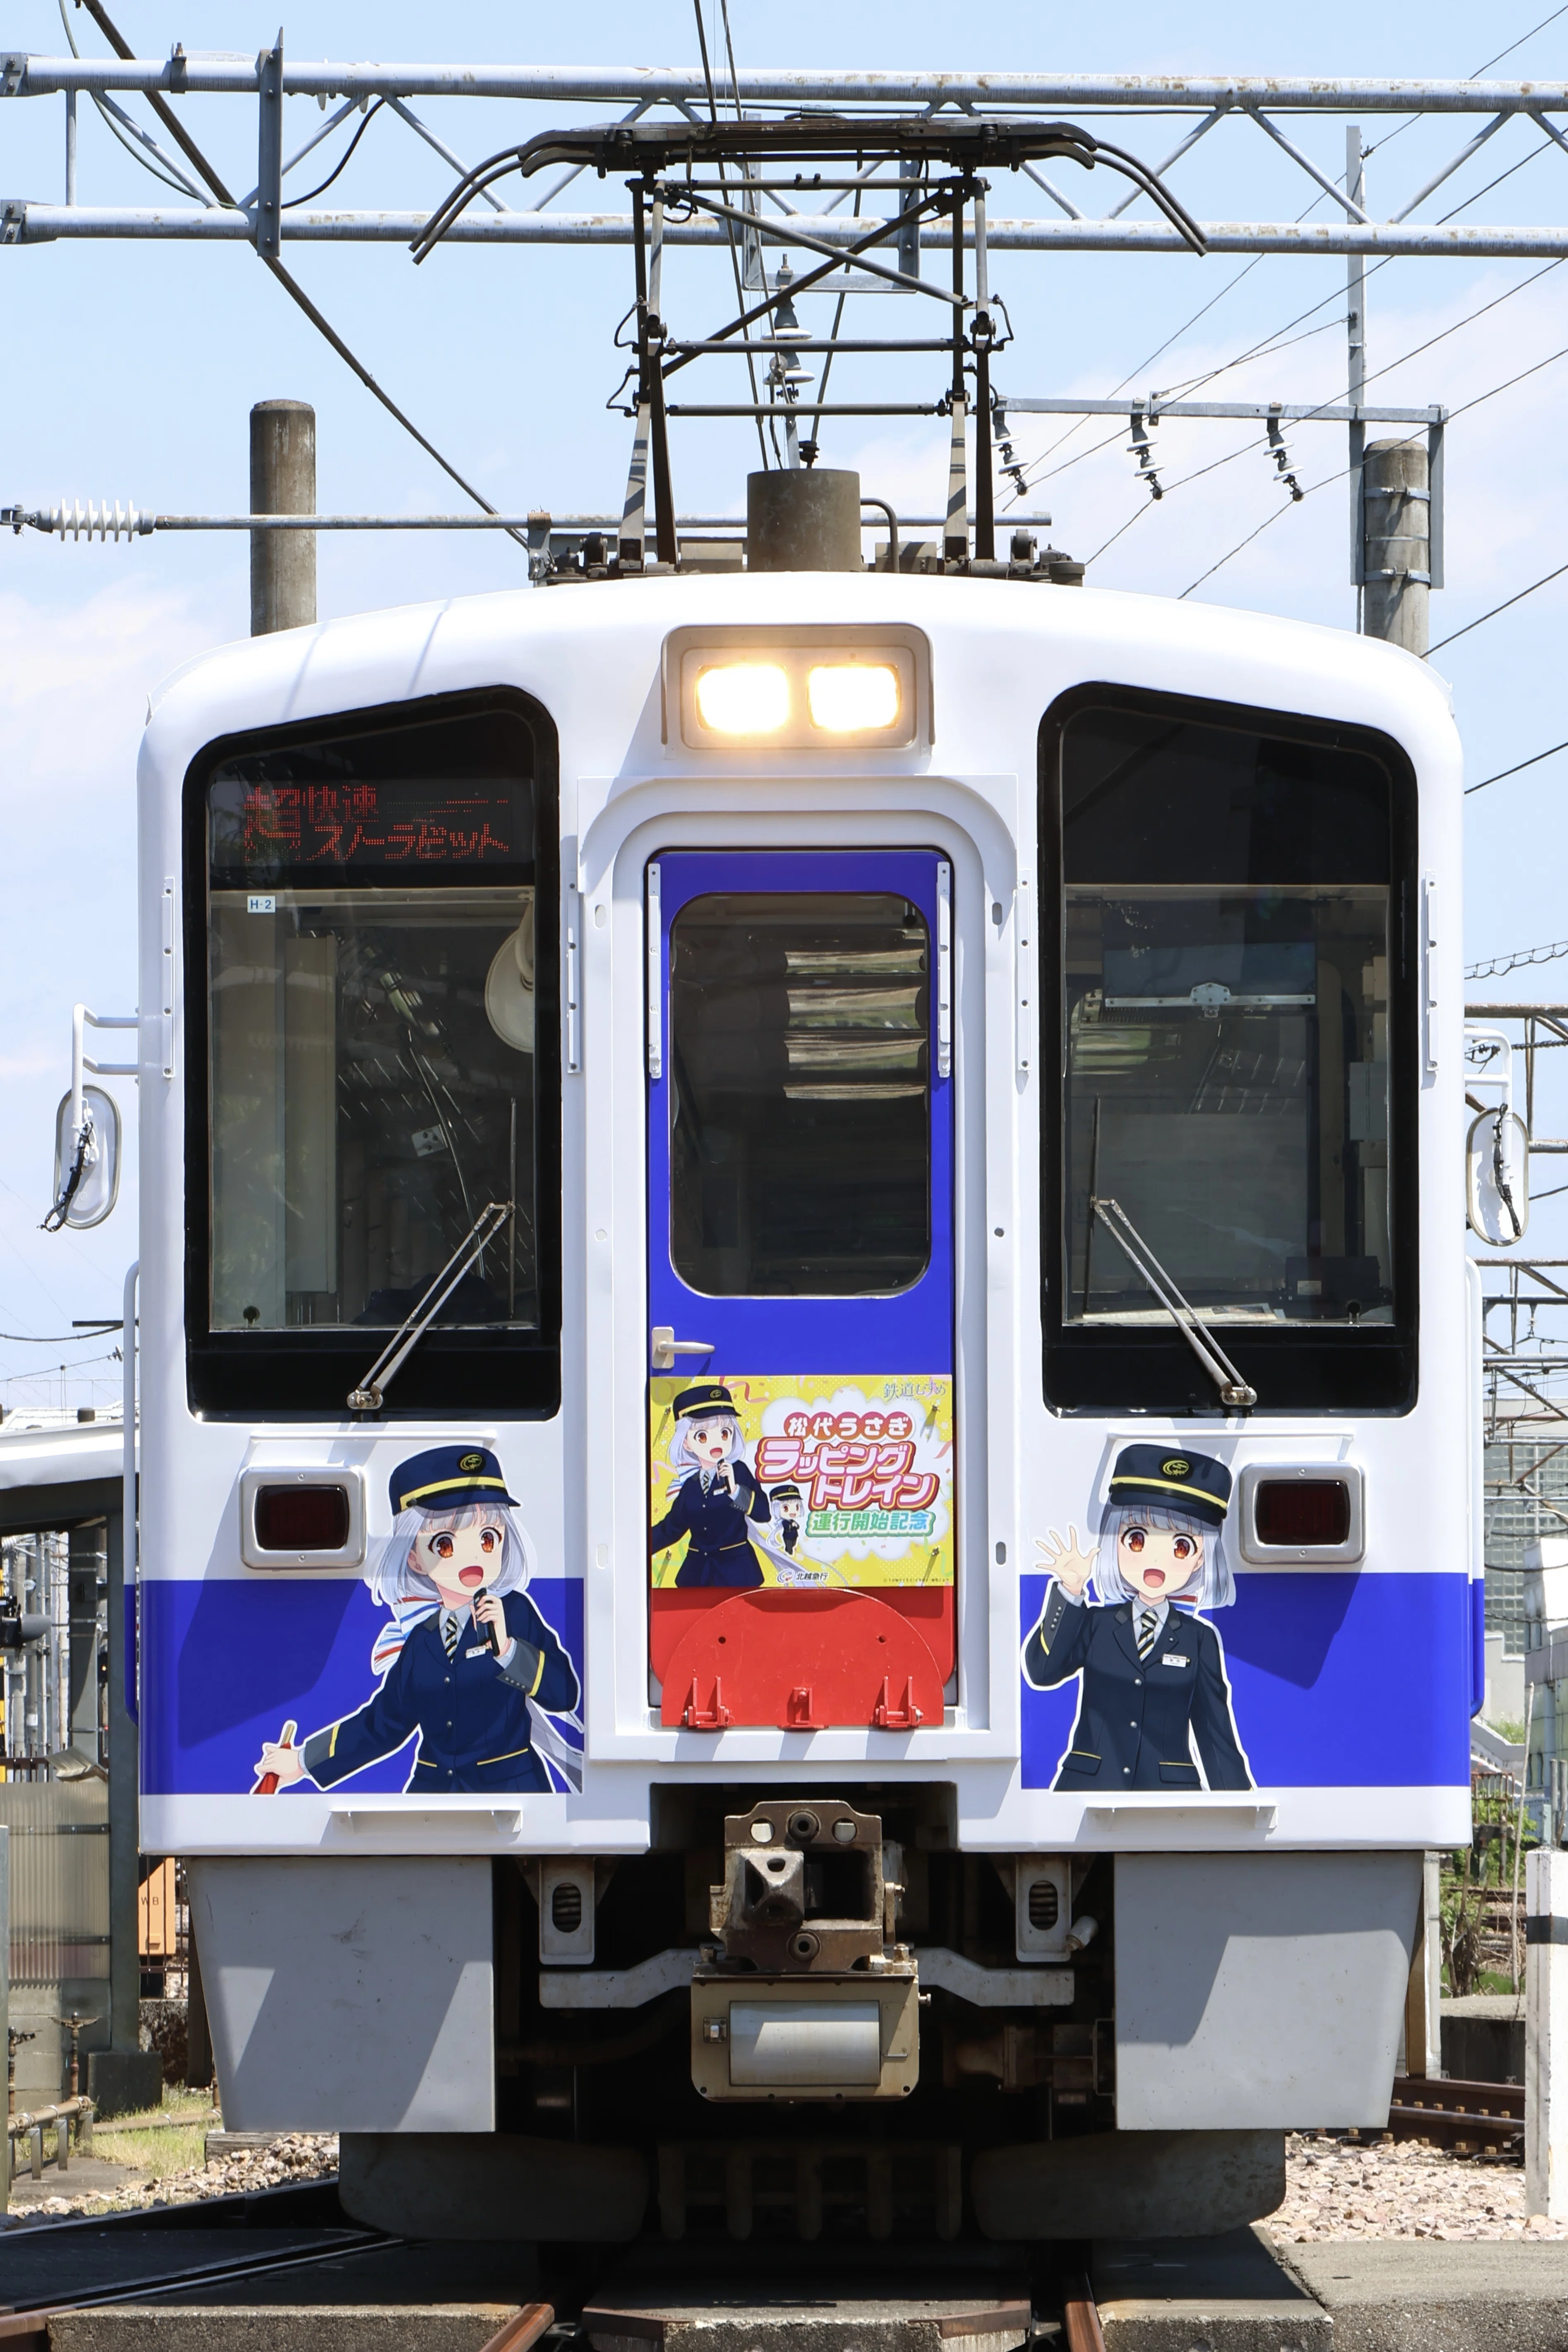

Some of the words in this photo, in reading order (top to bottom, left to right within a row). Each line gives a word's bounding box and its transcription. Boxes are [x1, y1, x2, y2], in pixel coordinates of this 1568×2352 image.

[244, 784, 379, 838] 超快速
[306, 823, 509, 861] スノーラビット
[250, 899, 272, 909] H-2
[884, 1381, 946, 1402] 鉄道むすめ
[788, 1416, 909, 1437] 松代うさぎ
[762, 1439, 911, 1477] ラッピング
[813, 1472, 933, 1506] トレイン
[812, 1511, 930, 1531] 運行開始記念
